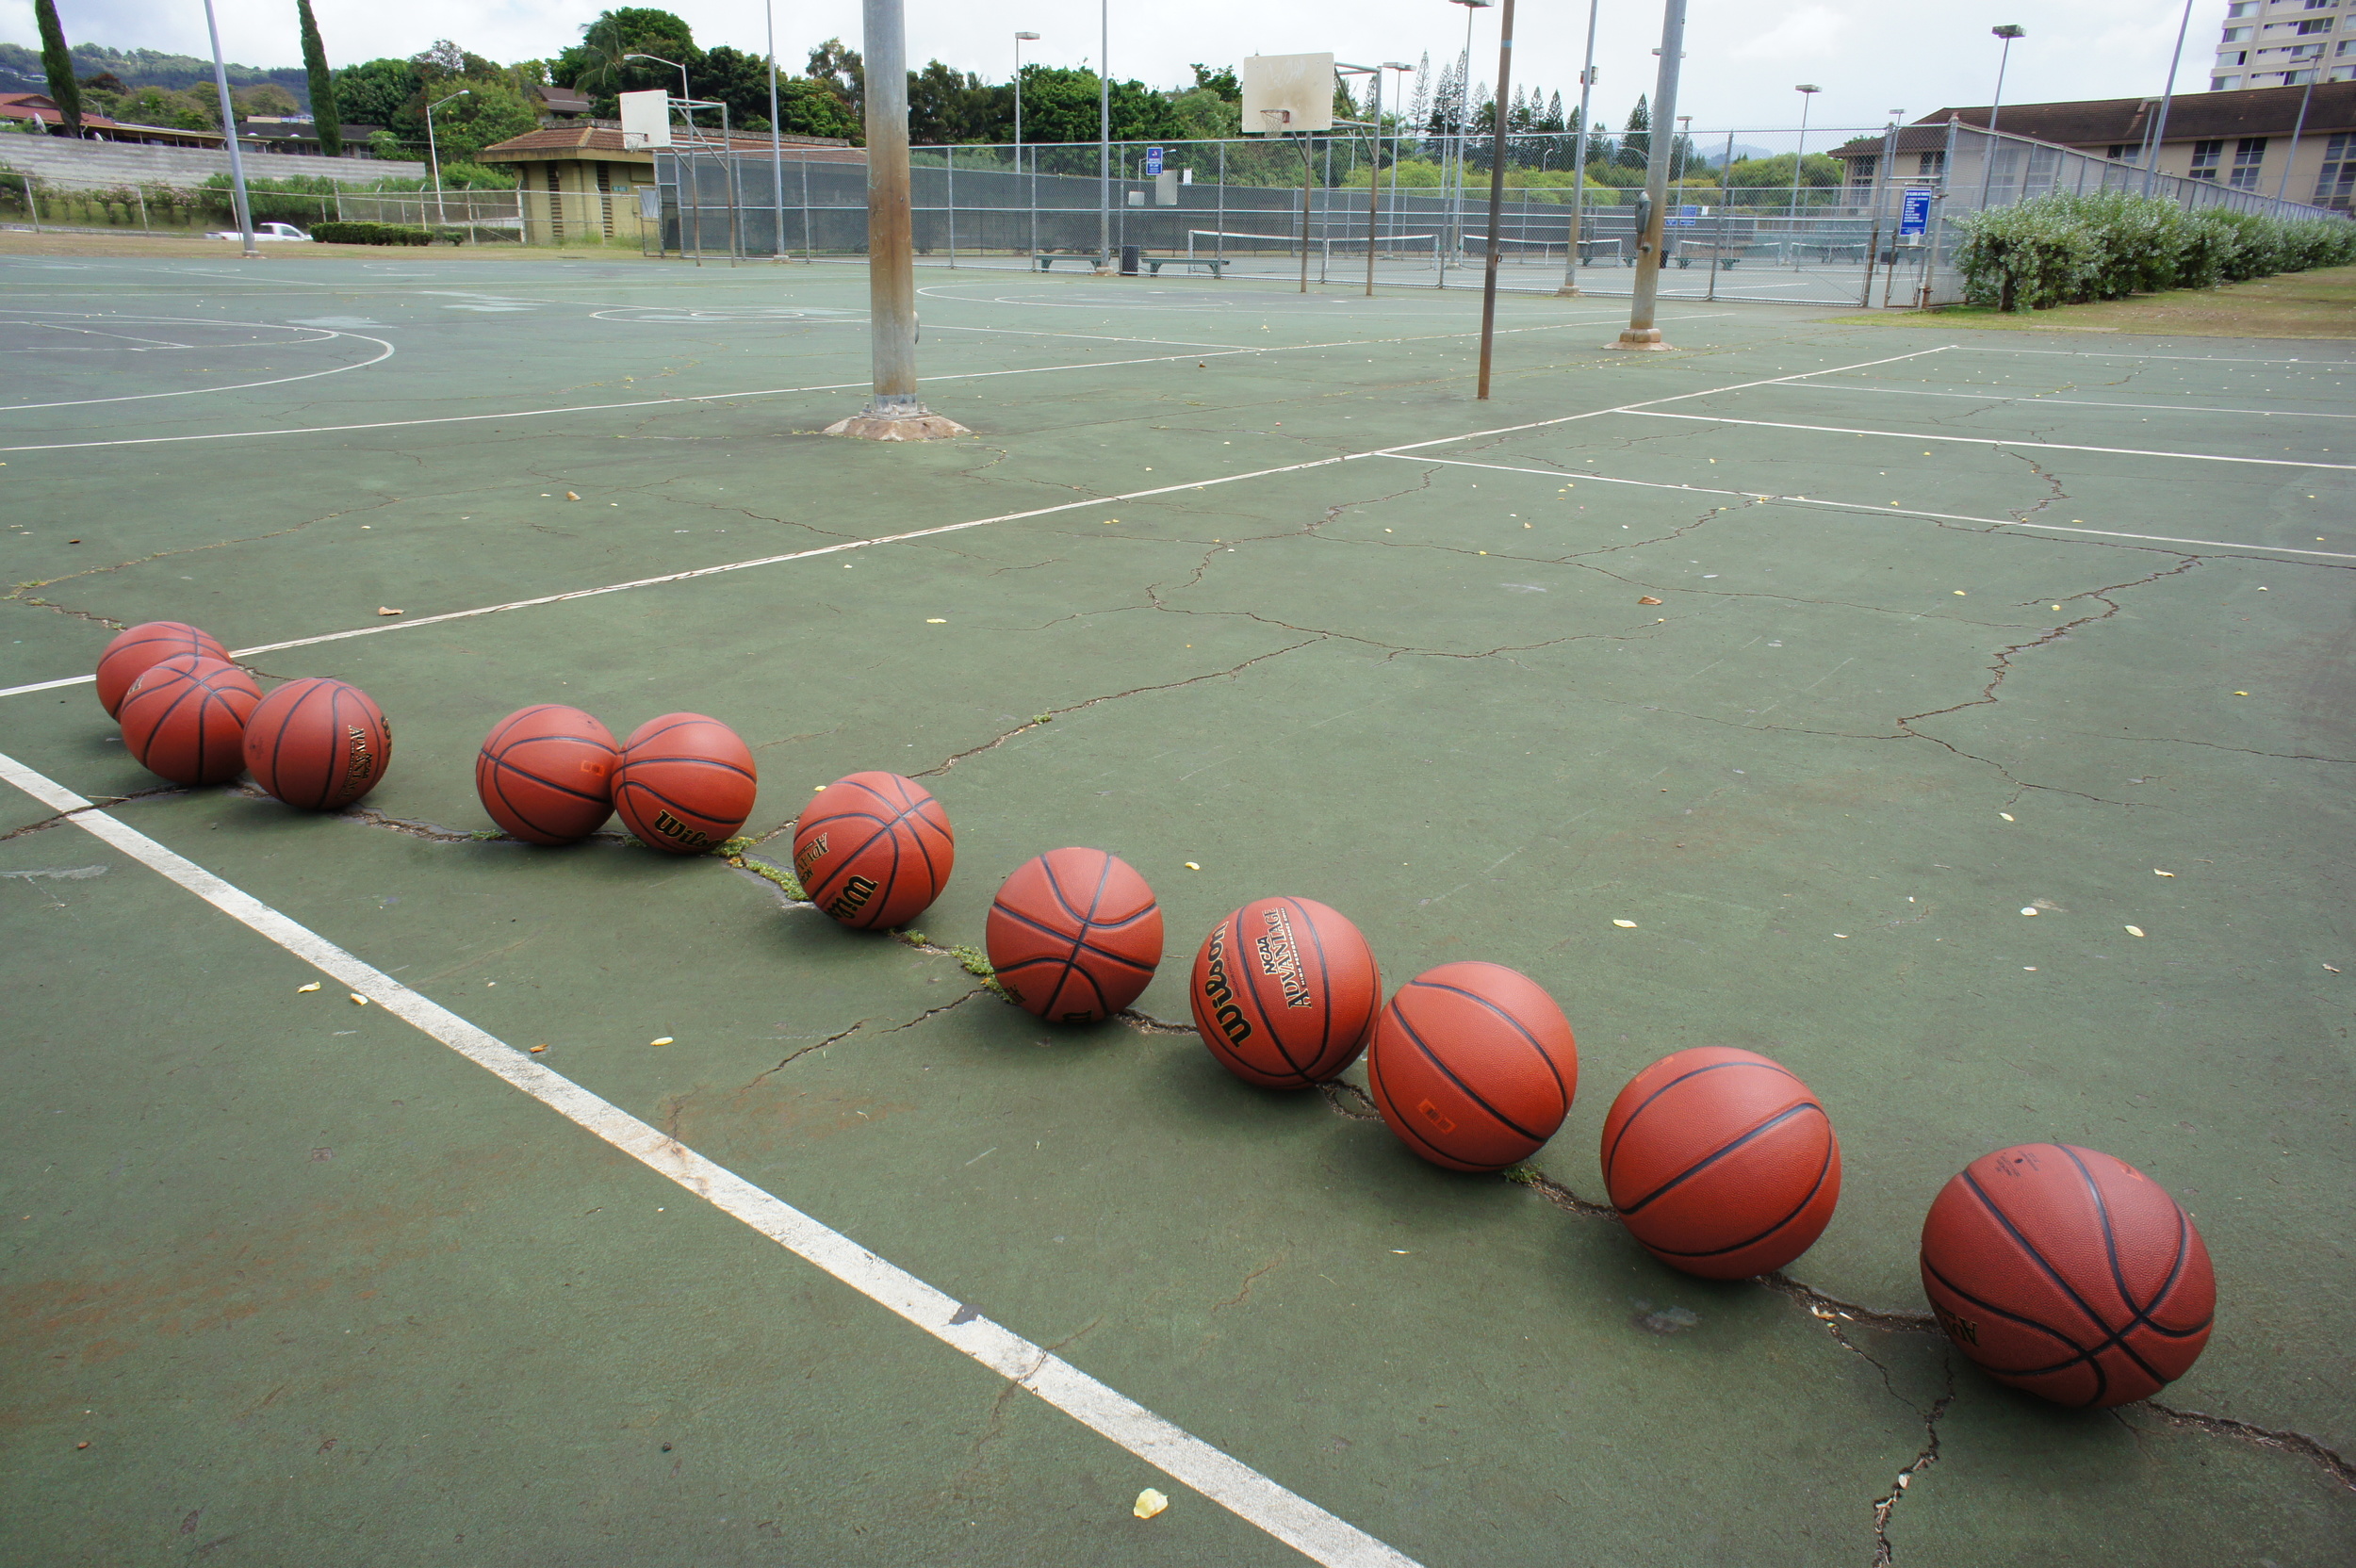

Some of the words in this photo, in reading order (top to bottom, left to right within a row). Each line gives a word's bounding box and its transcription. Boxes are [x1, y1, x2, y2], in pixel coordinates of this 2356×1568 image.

[826, 874, 879, 921] Wils
[1255, 935, 1278, 975] NCAA
[1262, 907, 1312, 1009] ADVANTAGE
[1298, 968, 1306, 986] HIGH
[1204, 921, 1252, 1048] Wilson
